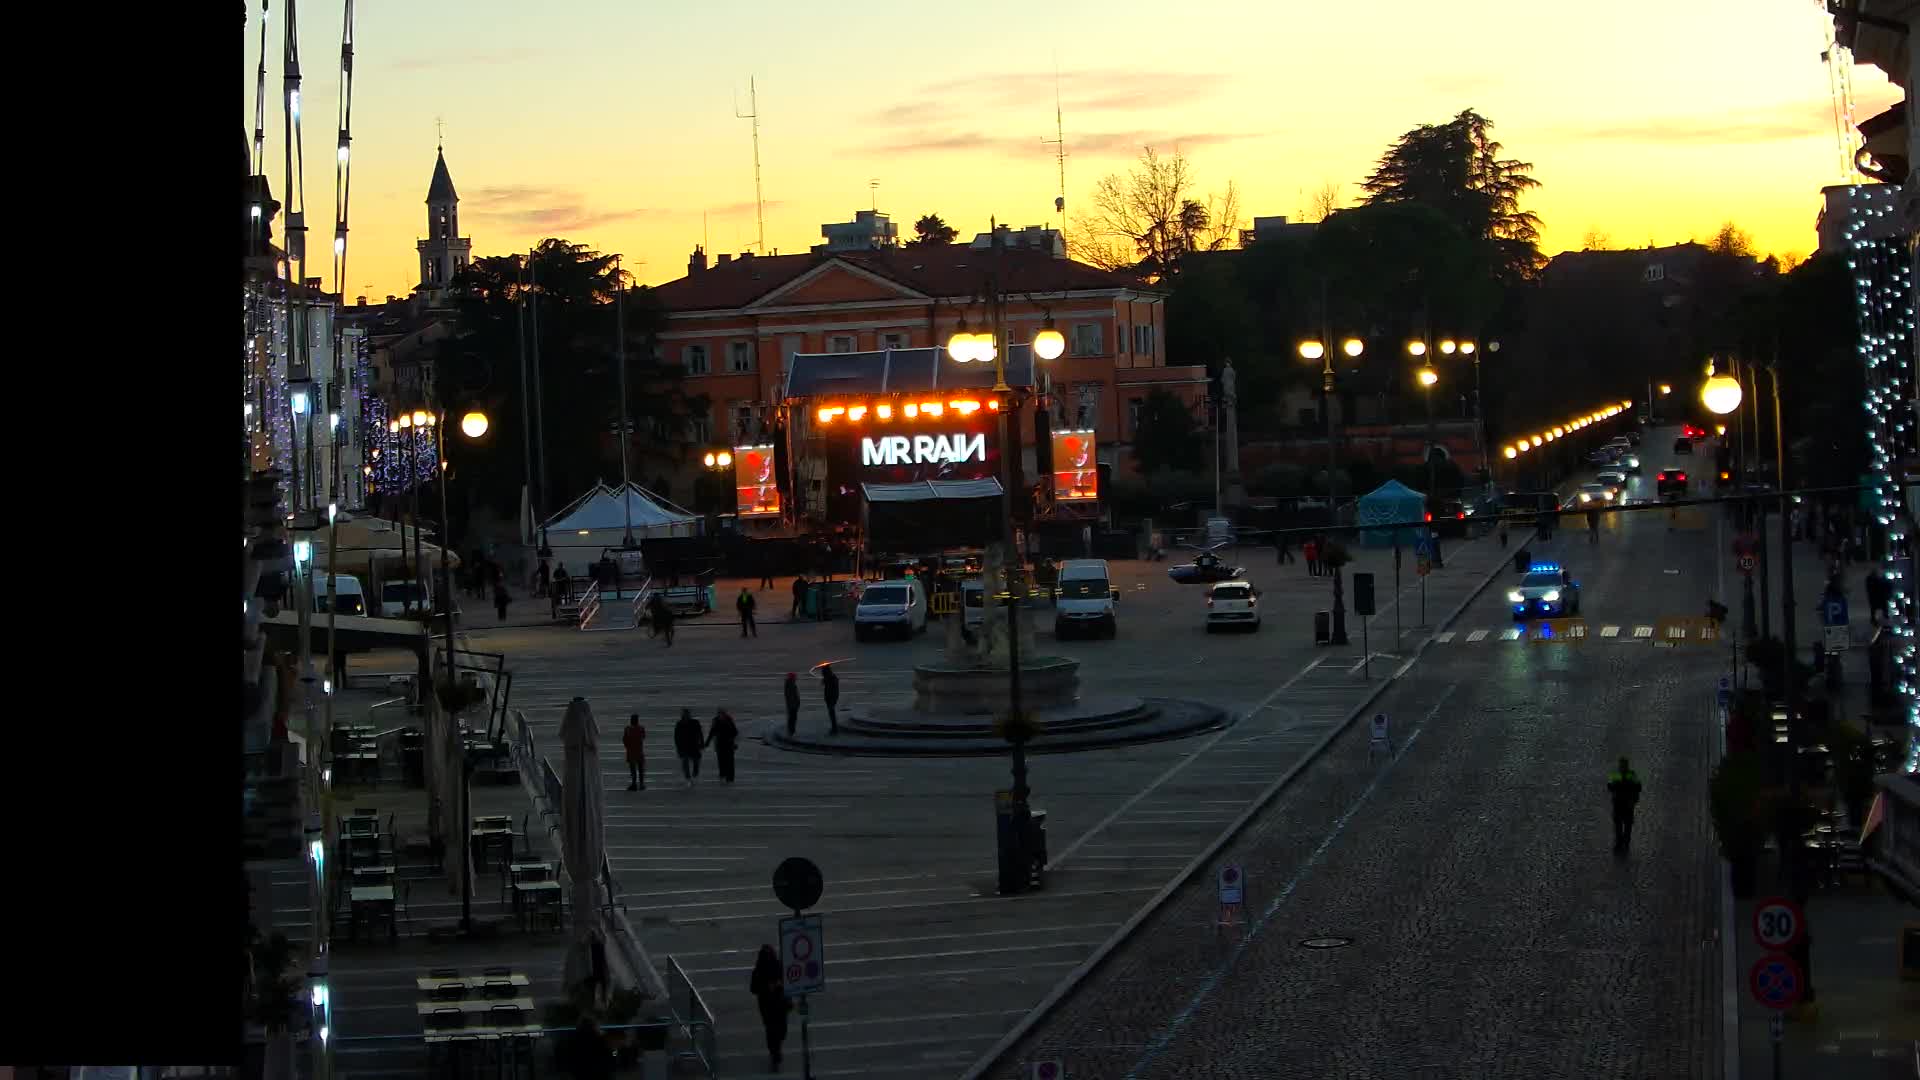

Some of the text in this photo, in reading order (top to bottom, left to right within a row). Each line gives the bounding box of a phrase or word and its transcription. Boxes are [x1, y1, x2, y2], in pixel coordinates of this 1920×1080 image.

[862, 436, 912, 466] MR
[1827, 602, 1842, 621] P
[1762, 912, 1791, 937] 30
